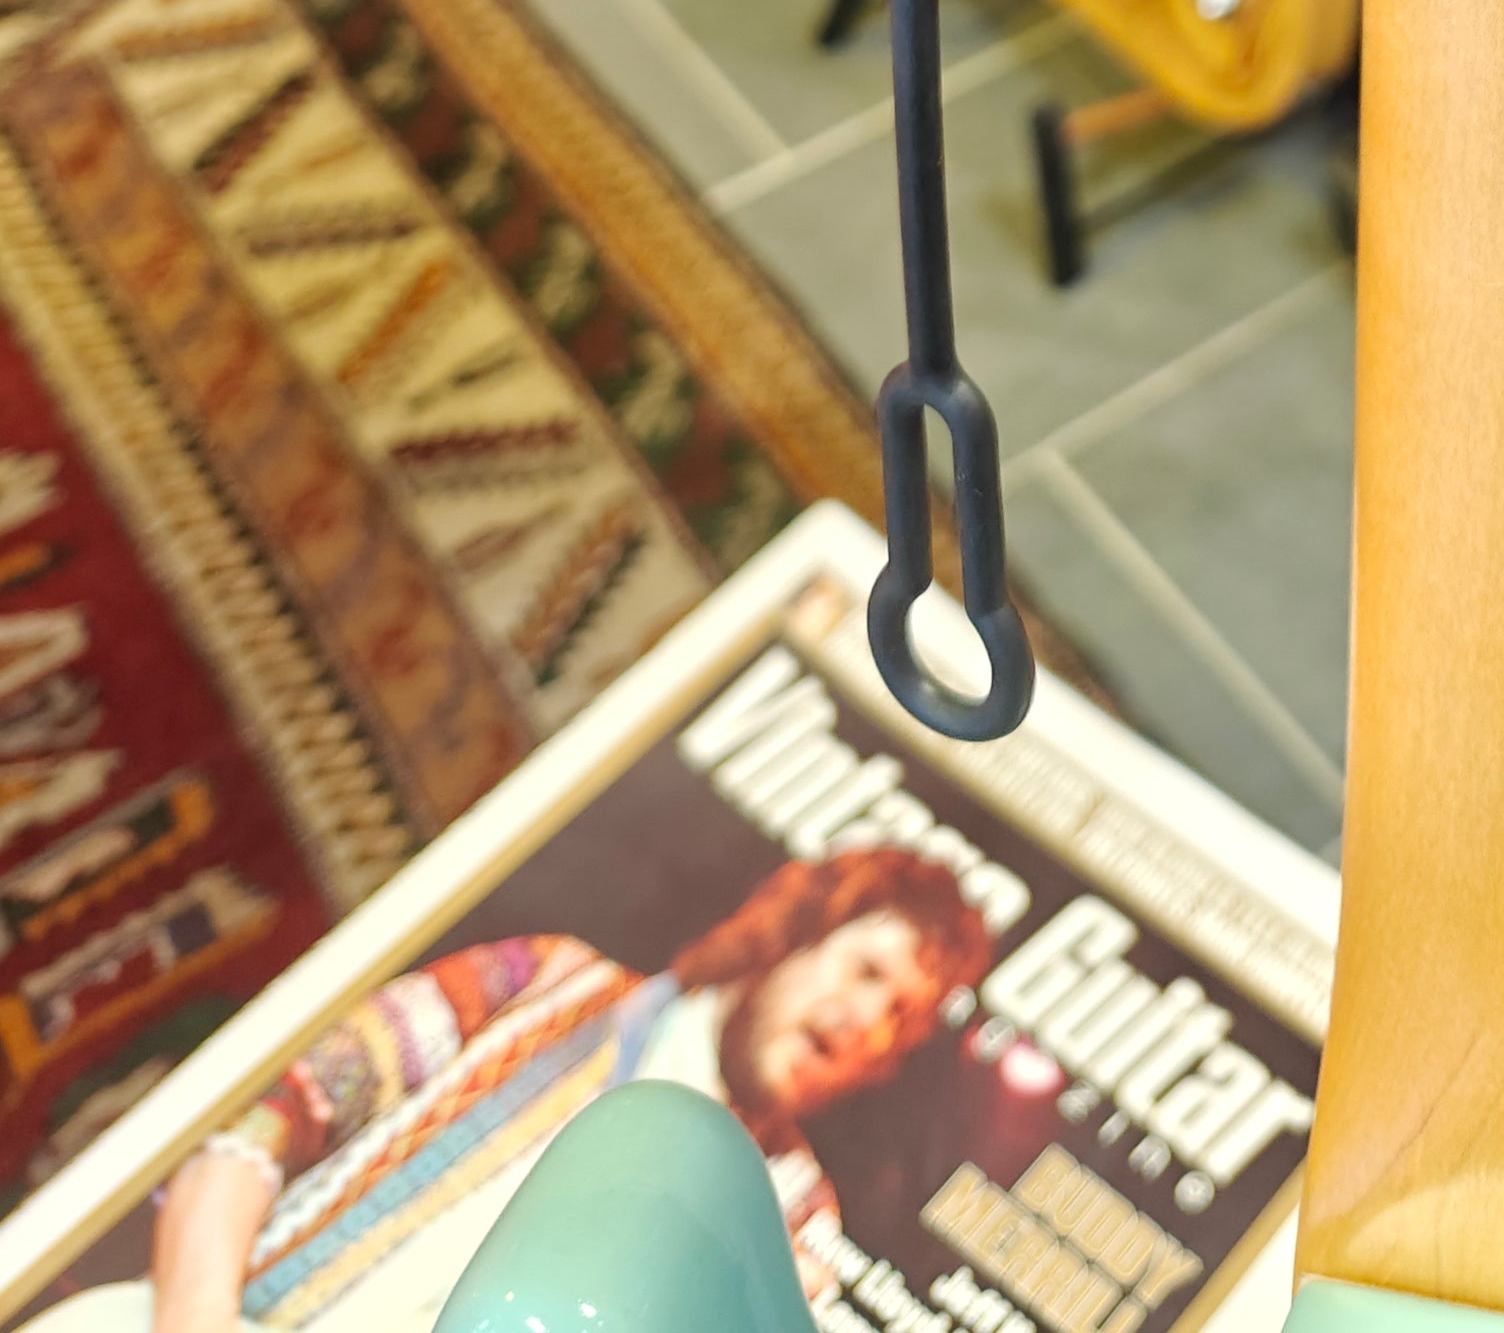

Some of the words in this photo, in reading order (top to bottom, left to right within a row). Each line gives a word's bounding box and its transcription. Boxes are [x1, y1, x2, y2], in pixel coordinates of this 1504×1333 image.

[678, 643, 1032, 937] Vinta
[979, 893, 1315, 1188] Guitar
[1008, 1141, 1205, 1312] BUDDY
